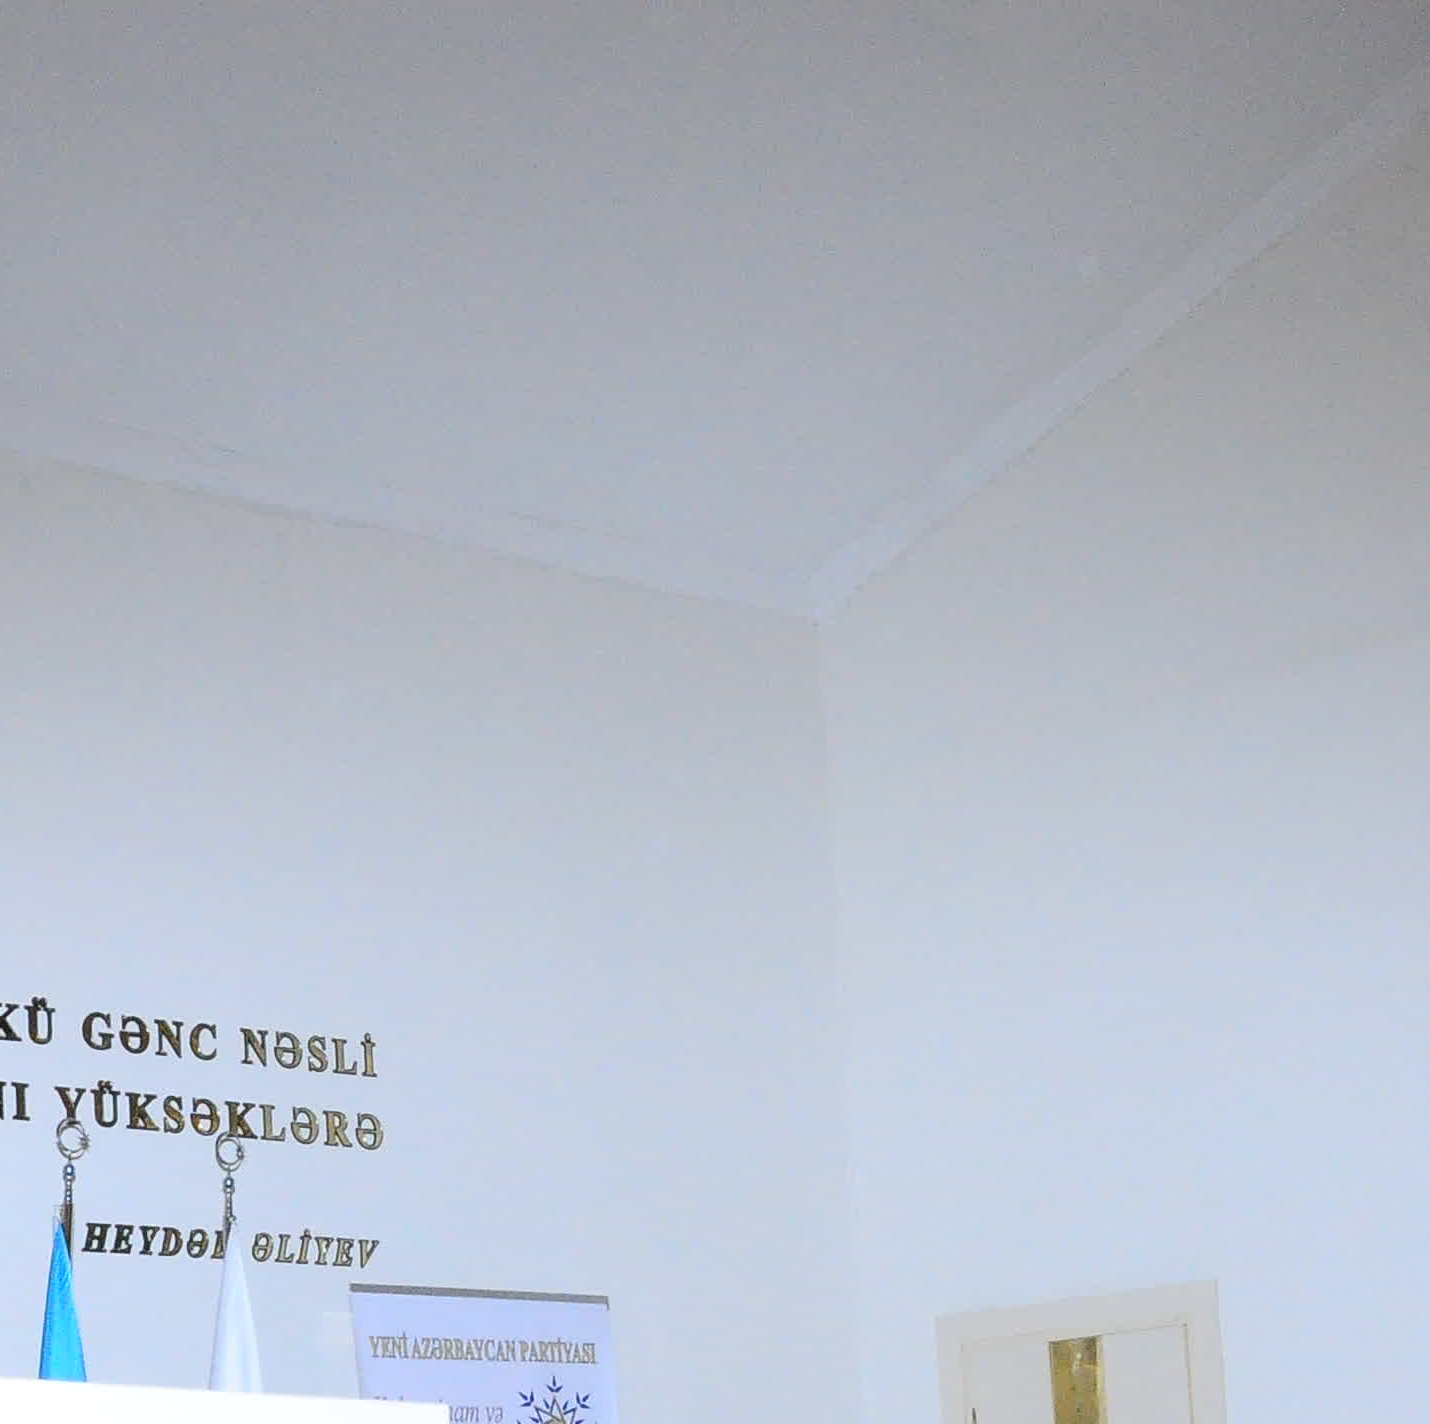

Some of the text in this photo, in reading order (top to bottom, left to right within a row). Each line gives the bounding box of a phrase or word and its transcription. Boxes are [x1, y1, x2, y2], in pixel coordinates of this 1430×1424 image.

[82, 1011, 218, 1060] GƏNC
[241, 1026, 380, 1078] NƏSLİ
[55, 1080, 385, 1150] YÜKSƏKLƏRƏ
[251, 1228, 381, 1269] ƏLİYEV
[369, 1330, 597, 1364] YENİ AZƏRBAYCAN PARTİYASI
[485, 1406, 504, 1424] və
